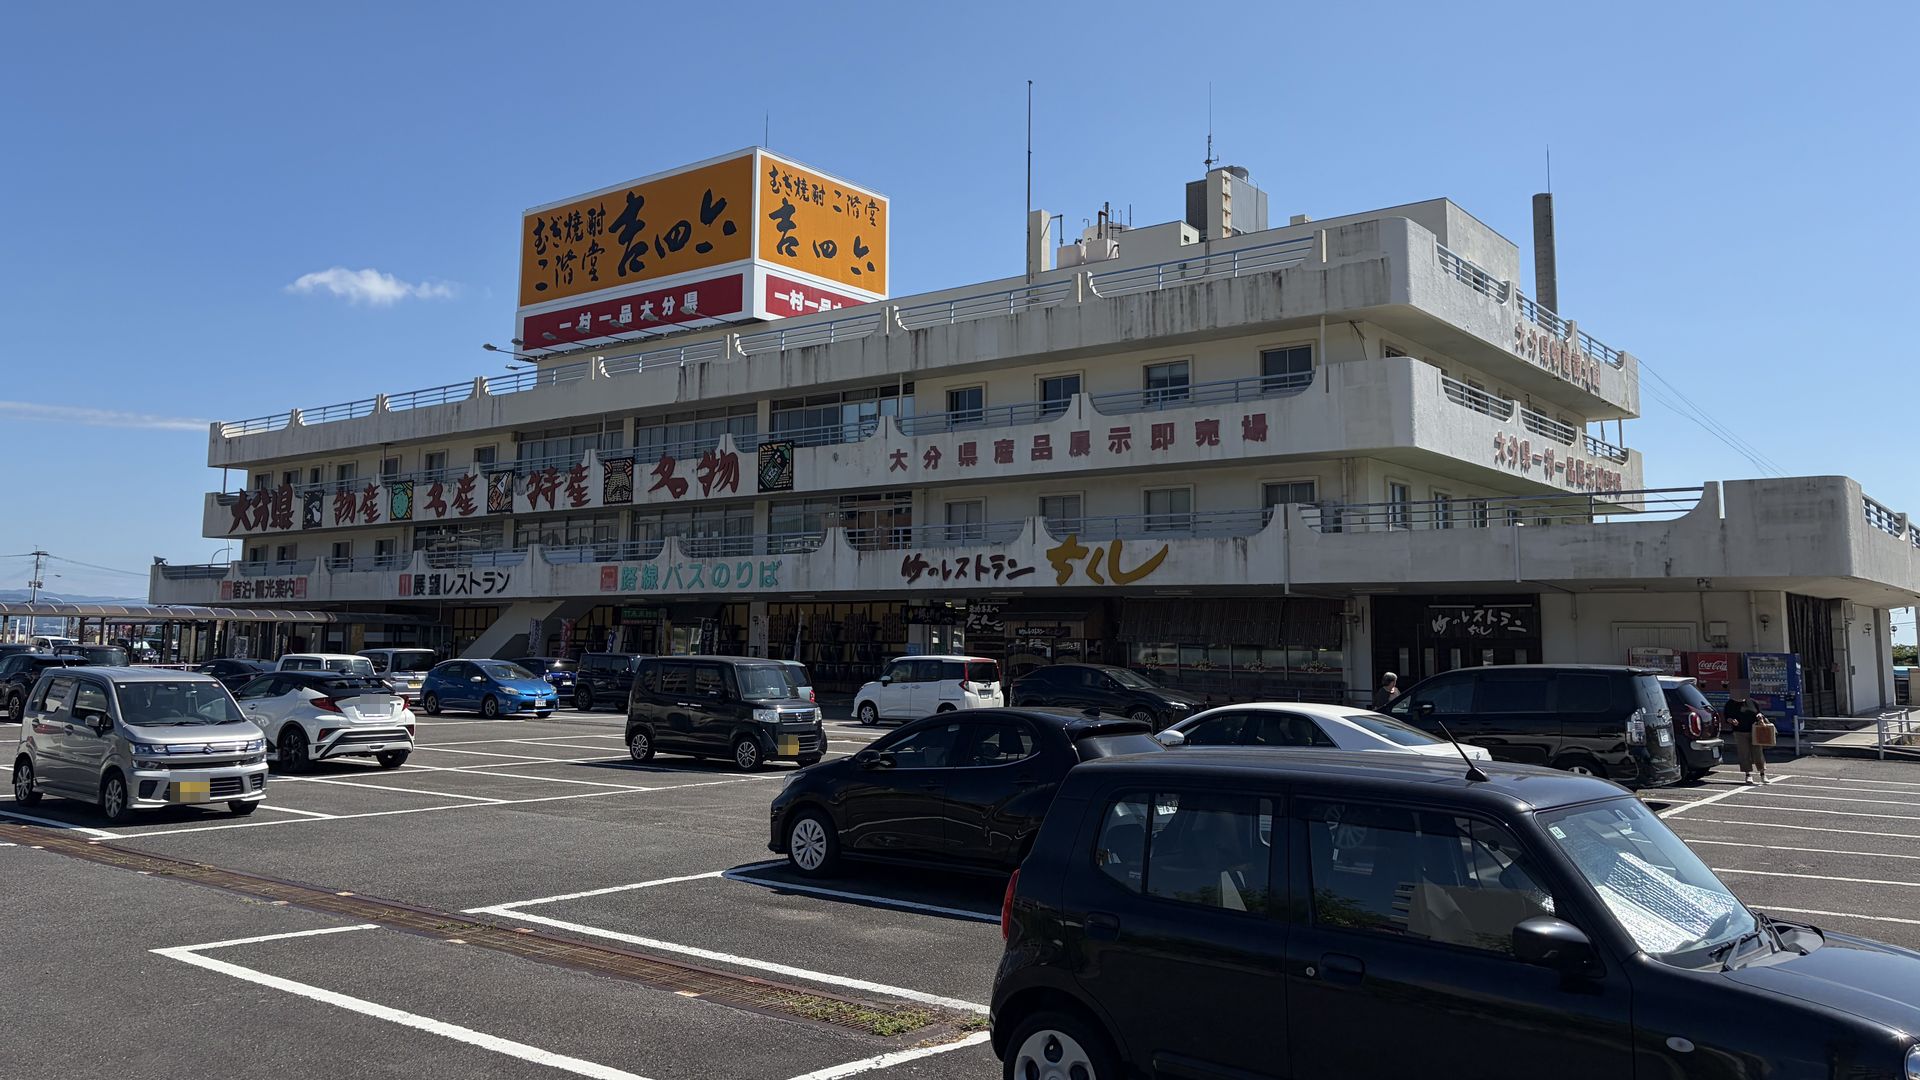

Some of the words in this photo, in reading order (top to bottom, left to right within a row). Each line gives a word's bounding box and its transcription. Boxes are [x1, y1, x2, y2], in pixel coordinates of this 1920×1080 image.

[769, 164, 825, 207] むぎ焼酎
[833, 190, 880, 227] 二階堂
[533, 202, 606, 256] むぎ焼酎
[535, 239, 606, 292] 二階堂
[559, 291, 698, 332] 一村一品大分県
[889, 414, 1269, 472] 大分県産品展示即売場
[229, 483, 294, 534] 大分県
[332, 482, 381, 526] 物産
[423, 473, 478, 518] 名産
[527, 462, 591, 511] 特産
[648, 450, 740, 498] 名物
[413, 571, 510, 597] 展望レストラン
[620, 560, 782, 592] 路線バスのりば
[901, 553, 1035, 584] 竹のレストラン
[1046, 533, 1168, 585] ちくし
[232, 578, 295, 600] 宿泊・観光案内
[1431, 608, 1527, 635] 竹のレストラン
